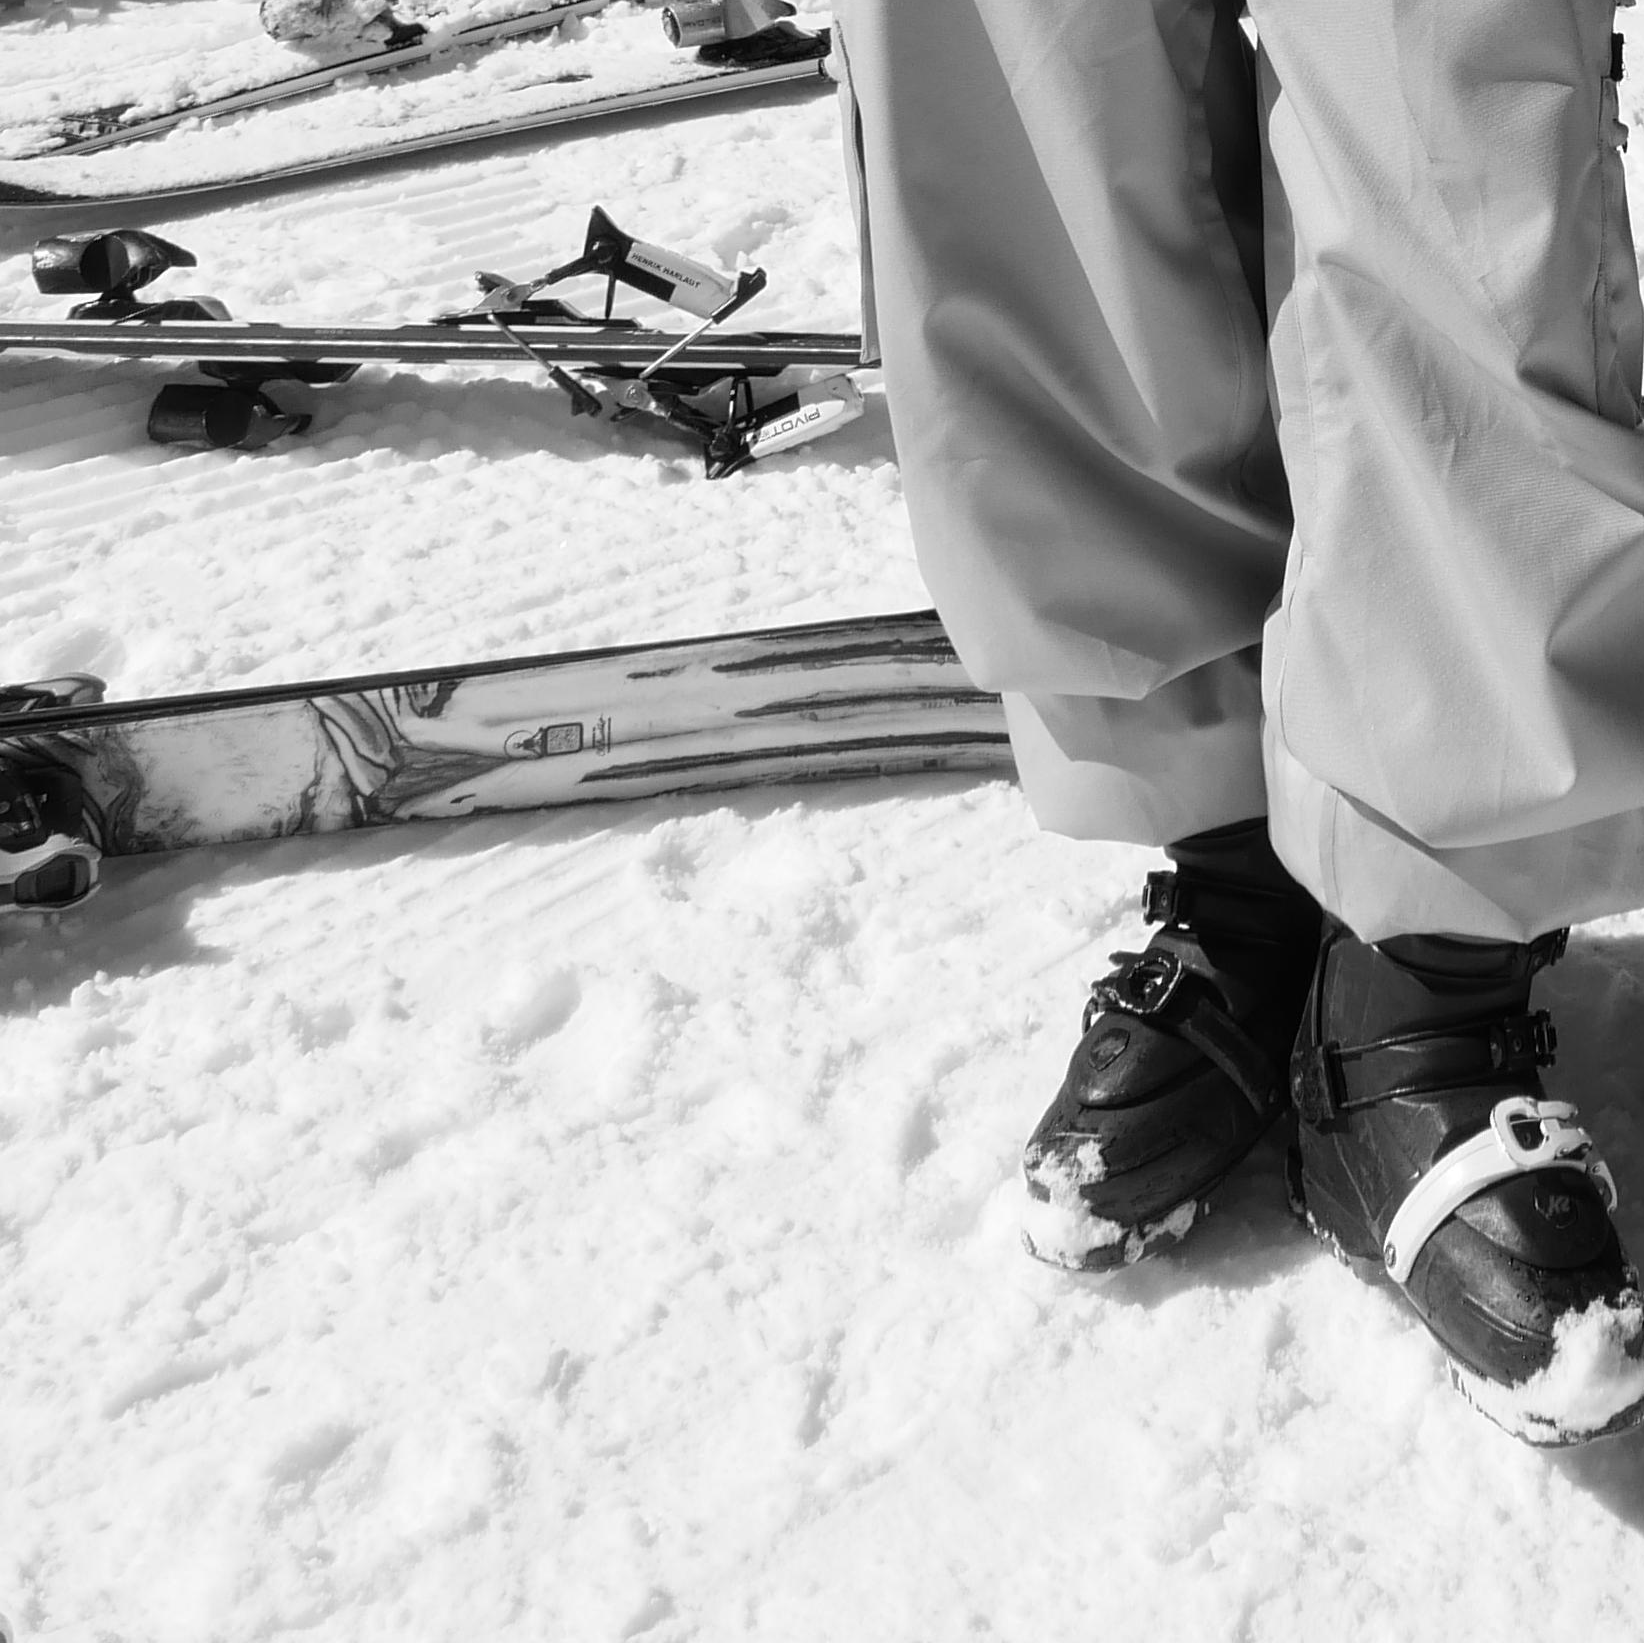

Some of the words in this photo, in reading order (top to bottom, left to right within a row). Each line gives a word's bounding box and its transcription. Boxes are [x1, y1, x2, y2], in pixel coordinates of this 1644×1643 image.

[631, 252, 661, 272] HENRIK
[662, 266, 702, 289] HARLAUT
[773, 407, 821, 435] PIVOT
